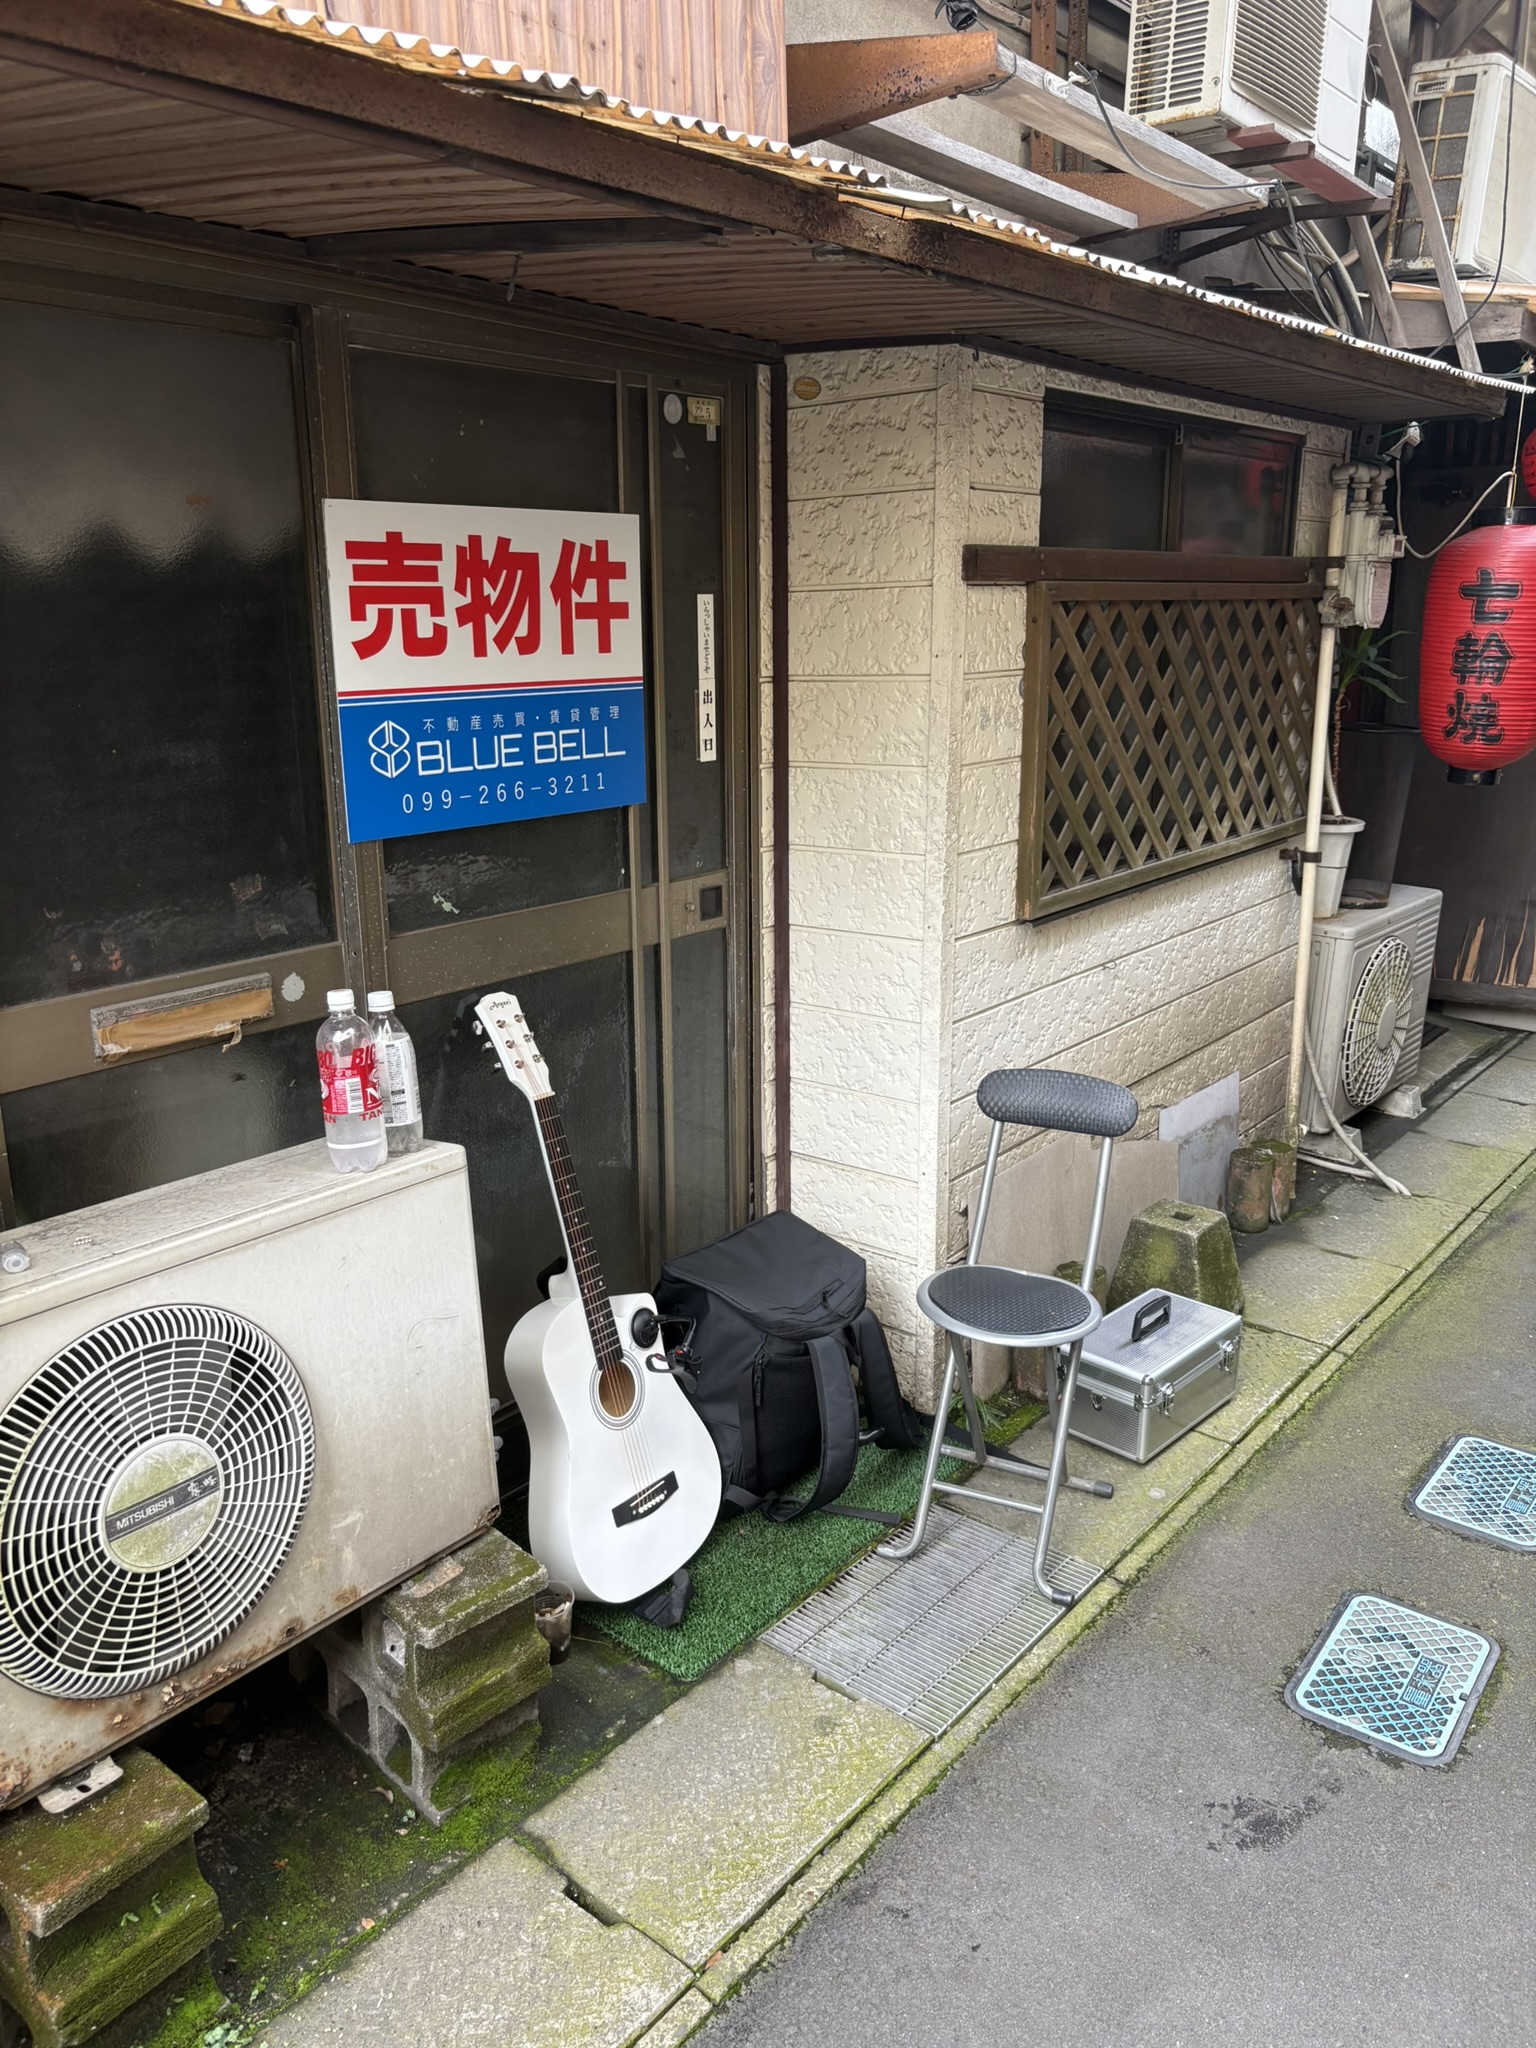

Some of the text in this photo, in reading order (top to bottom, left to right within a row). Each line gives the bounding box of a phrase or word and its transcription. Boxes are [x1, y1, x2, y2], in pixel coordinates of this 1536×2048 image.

[344, 531, 630, 661] 売物件
[422, 705, 620, 734] 不動産売買・賃貸管理
[416, 725, 627, 777] BLUE BELL
[402, 772, 606, 814] 099-266-3211
[115, 1495, 176, 1531] MITSUBISHI
